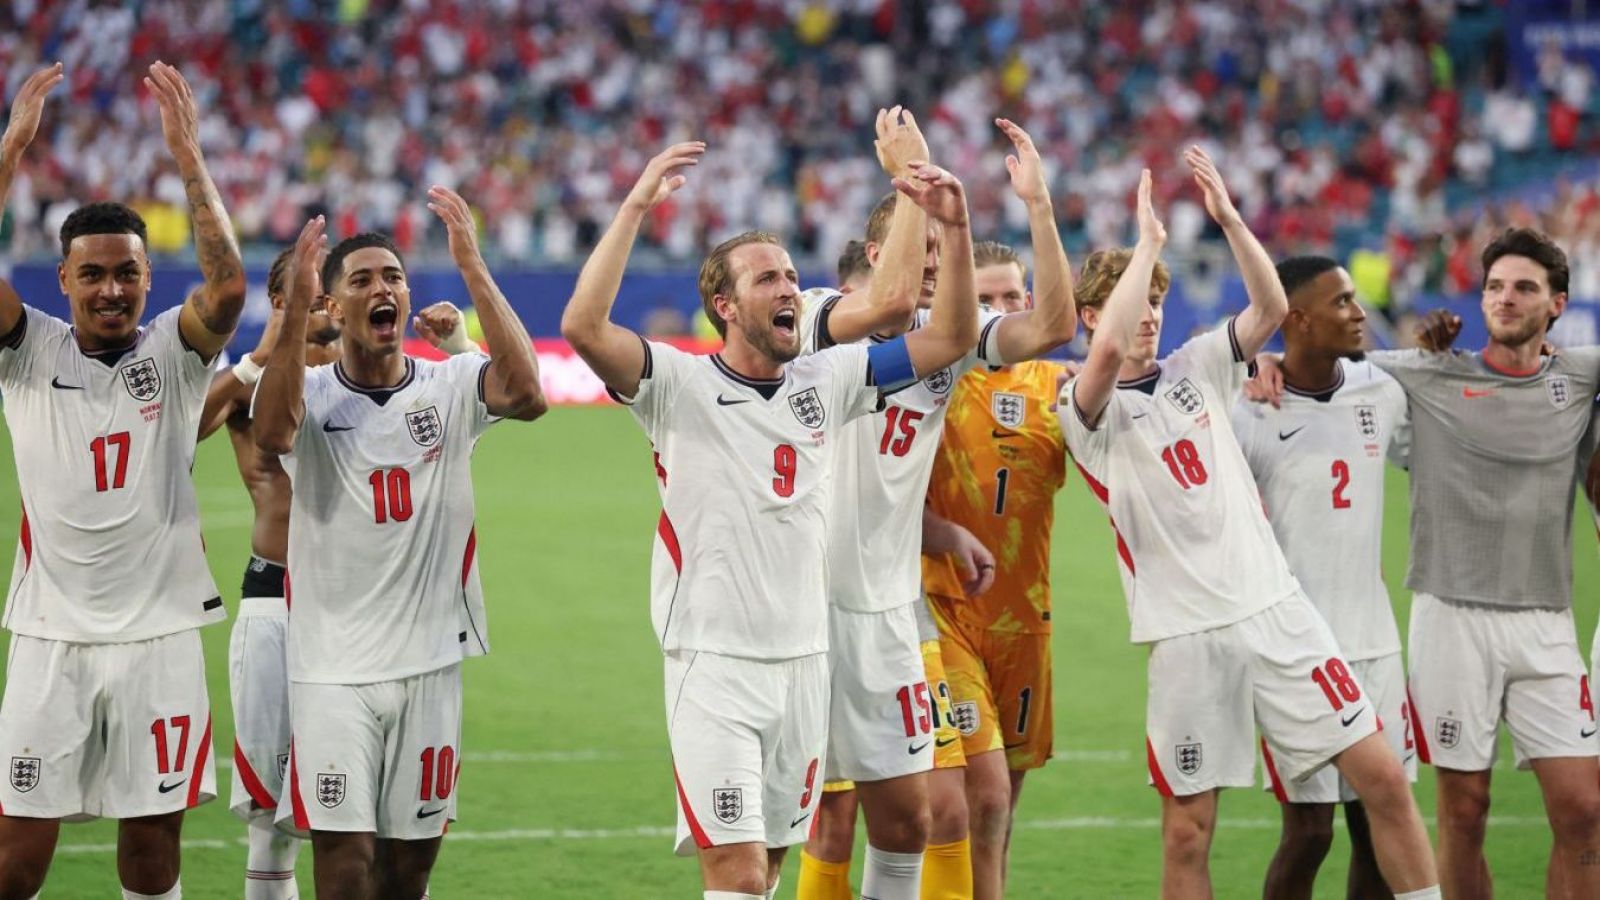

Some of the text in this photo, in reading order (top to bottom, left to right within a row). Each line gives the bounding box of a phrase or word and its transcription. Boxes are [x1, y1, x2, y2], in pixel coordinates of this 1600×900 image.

[879, 405, 924, 457] 15
[90, 431, 131, 492] 17
[772, 443, 797, 498] 9
[1161, 438, 1208, 491] 18
[1331, 459, 1351, 509] 2
[369, 466, 414, 524] 10
[994, 466, 1010, 517] 1
[896, 681, 931, 737] 15
[1016, 685, 1032, 735] 1
[1311, 657, 1360, 713] 18
[150, 714, 191, 774] 17
[419, 744, 455, 801] 10
[799, 757, 819, 810] 9
